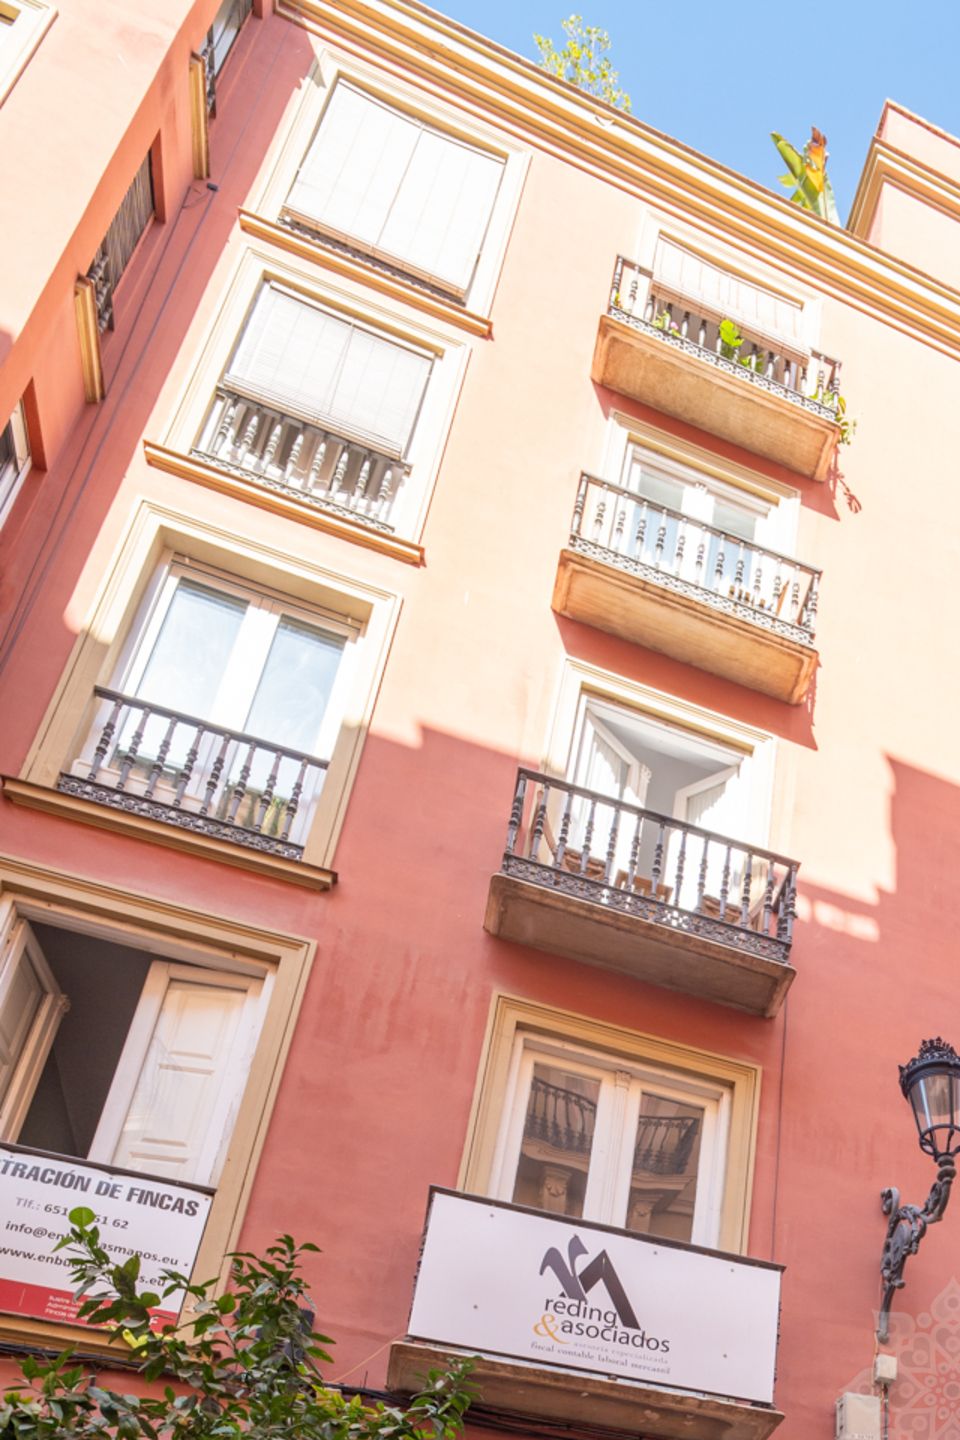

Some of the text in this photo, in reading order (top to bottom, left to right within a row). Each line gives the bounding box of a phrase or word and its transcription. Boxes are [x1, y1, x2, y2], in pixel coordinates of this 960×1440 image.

[95, 1179, 123, 1199] DE
[126, 1186, 200, 1217] FINCAS
[44, 1204, 68, 1217] 651
[112, 1219, 129, 1230] 62
[544, 1297, 617, 1328] reding
[561, 1319, 671, 1353] asociados
